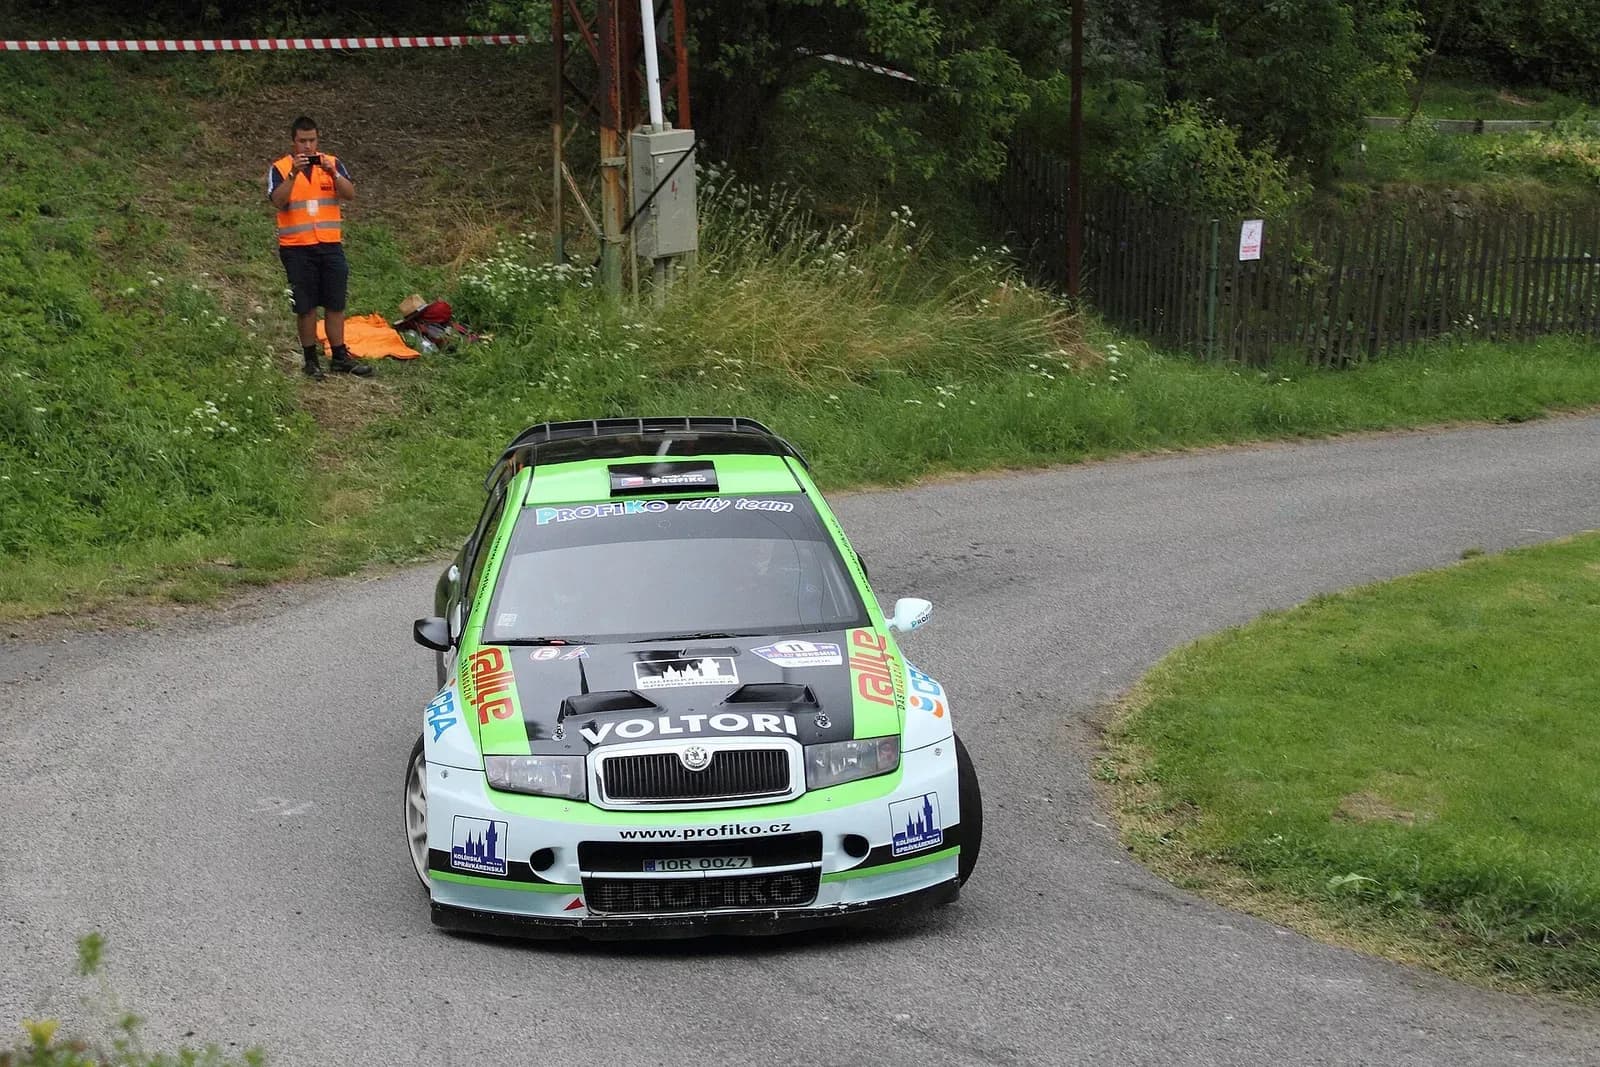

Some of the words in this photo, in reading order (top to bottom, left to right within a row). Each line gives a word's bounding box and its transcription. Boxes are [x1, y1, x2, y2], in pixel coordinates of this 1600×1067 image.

[536, 500, 669, 525] PROFIKO
[675, 497, 729, 513] rally
[734, 498, 795, 513] team
[849, 629, 895, 707] rallye
[468, 647, 515, 725] rallye
[578, 713, 798, 745] VOLTORI
[619, 823, 792, 840] www.profiko.cz
[700, 857, 750, 869] 0047
[601, 875, 802, 909] PROFIKO
